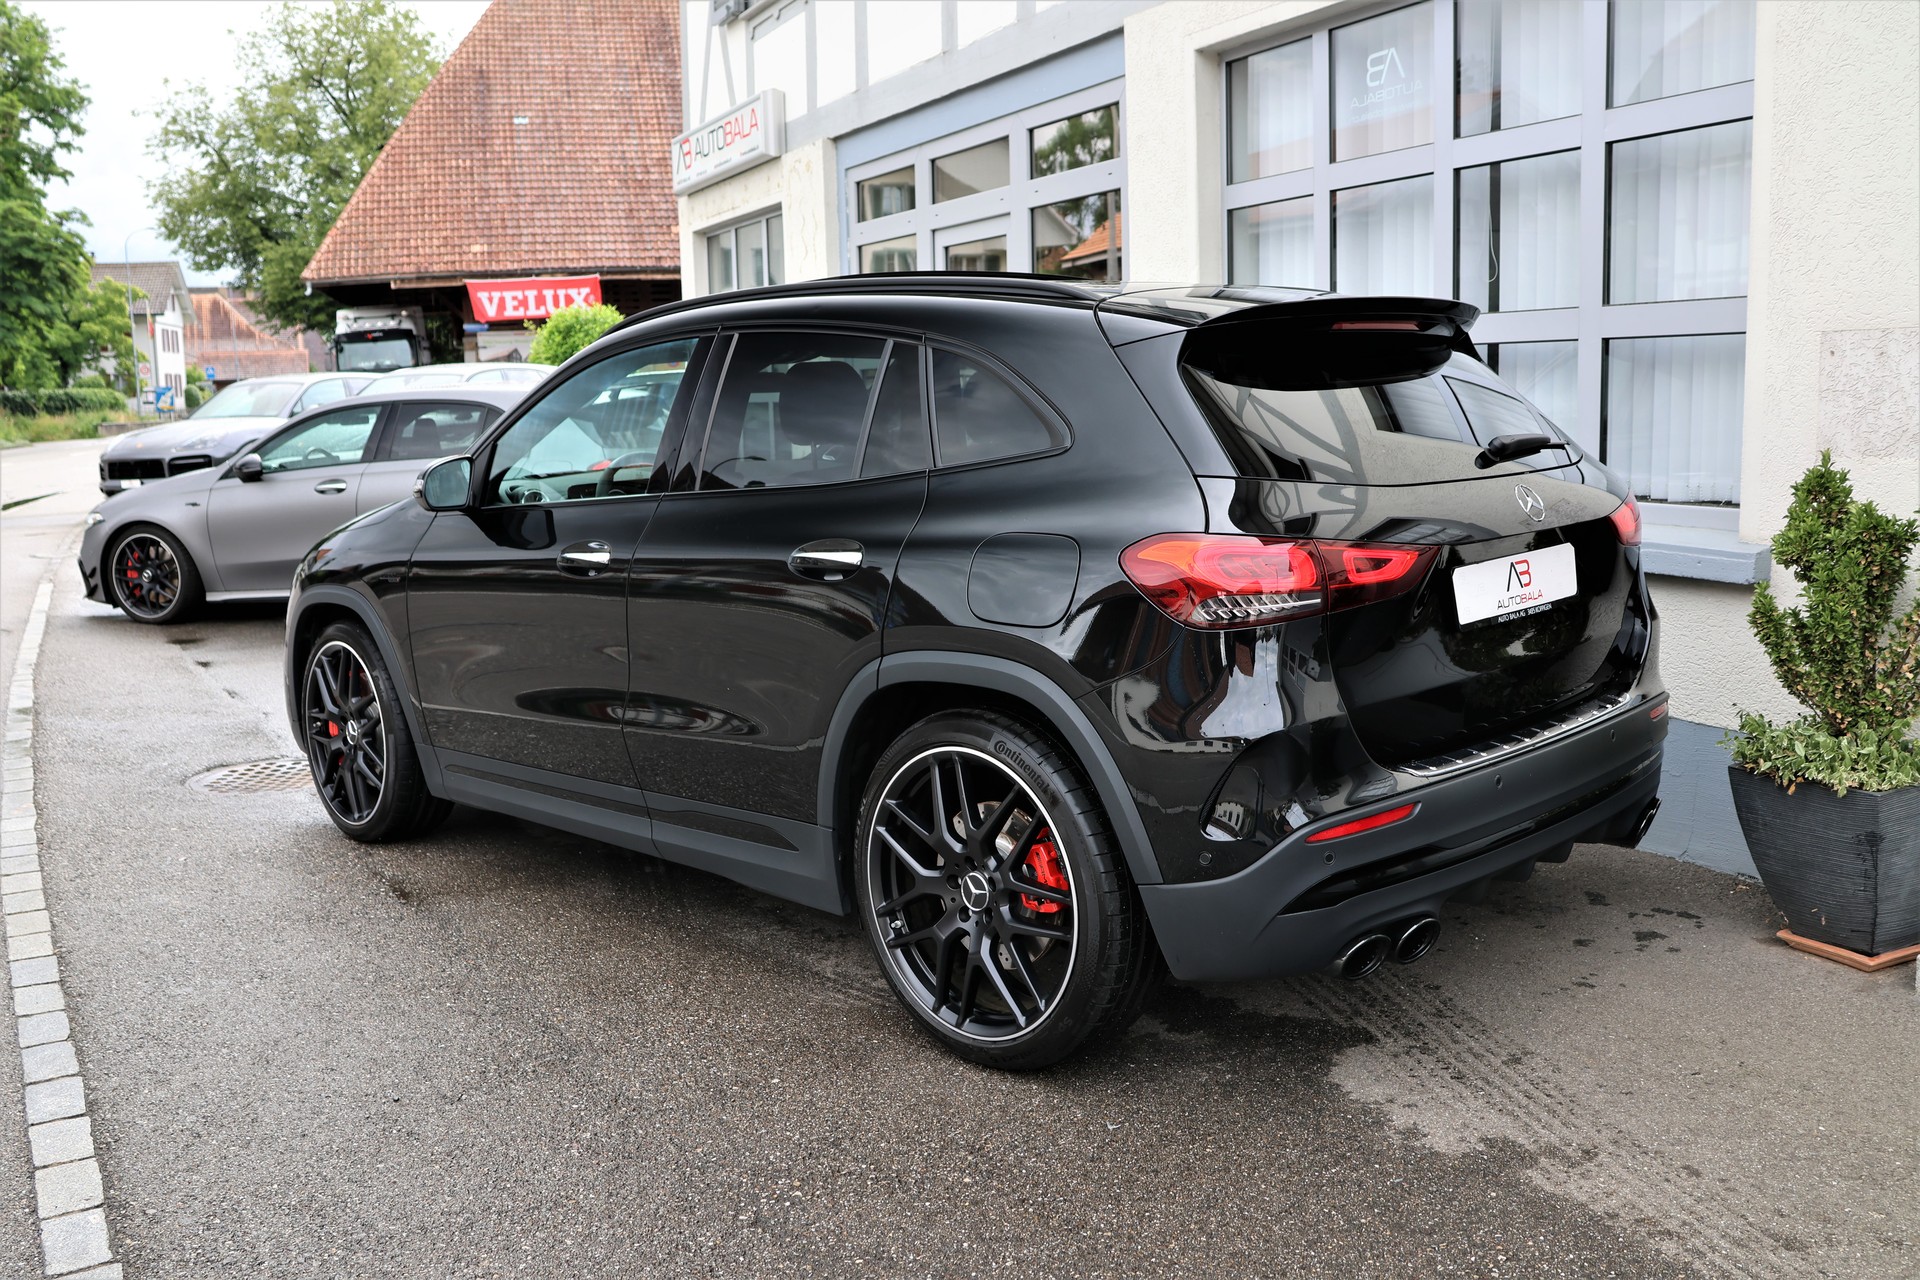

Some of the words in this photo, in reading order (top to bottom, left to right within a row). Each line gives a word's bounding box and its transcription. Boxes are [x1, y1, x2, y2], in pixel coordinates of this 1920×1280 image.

[694, 107, 760, 162] AUTOBALA
[477, 287, 591, 318] VELUX
[1496, 588, 1544, 611] AUTOBALA
[1497, 614, 1510, 623] AUTO
[1509, 611, 1519, 620] BALA
[993, 739, 1051, 794] Continental
